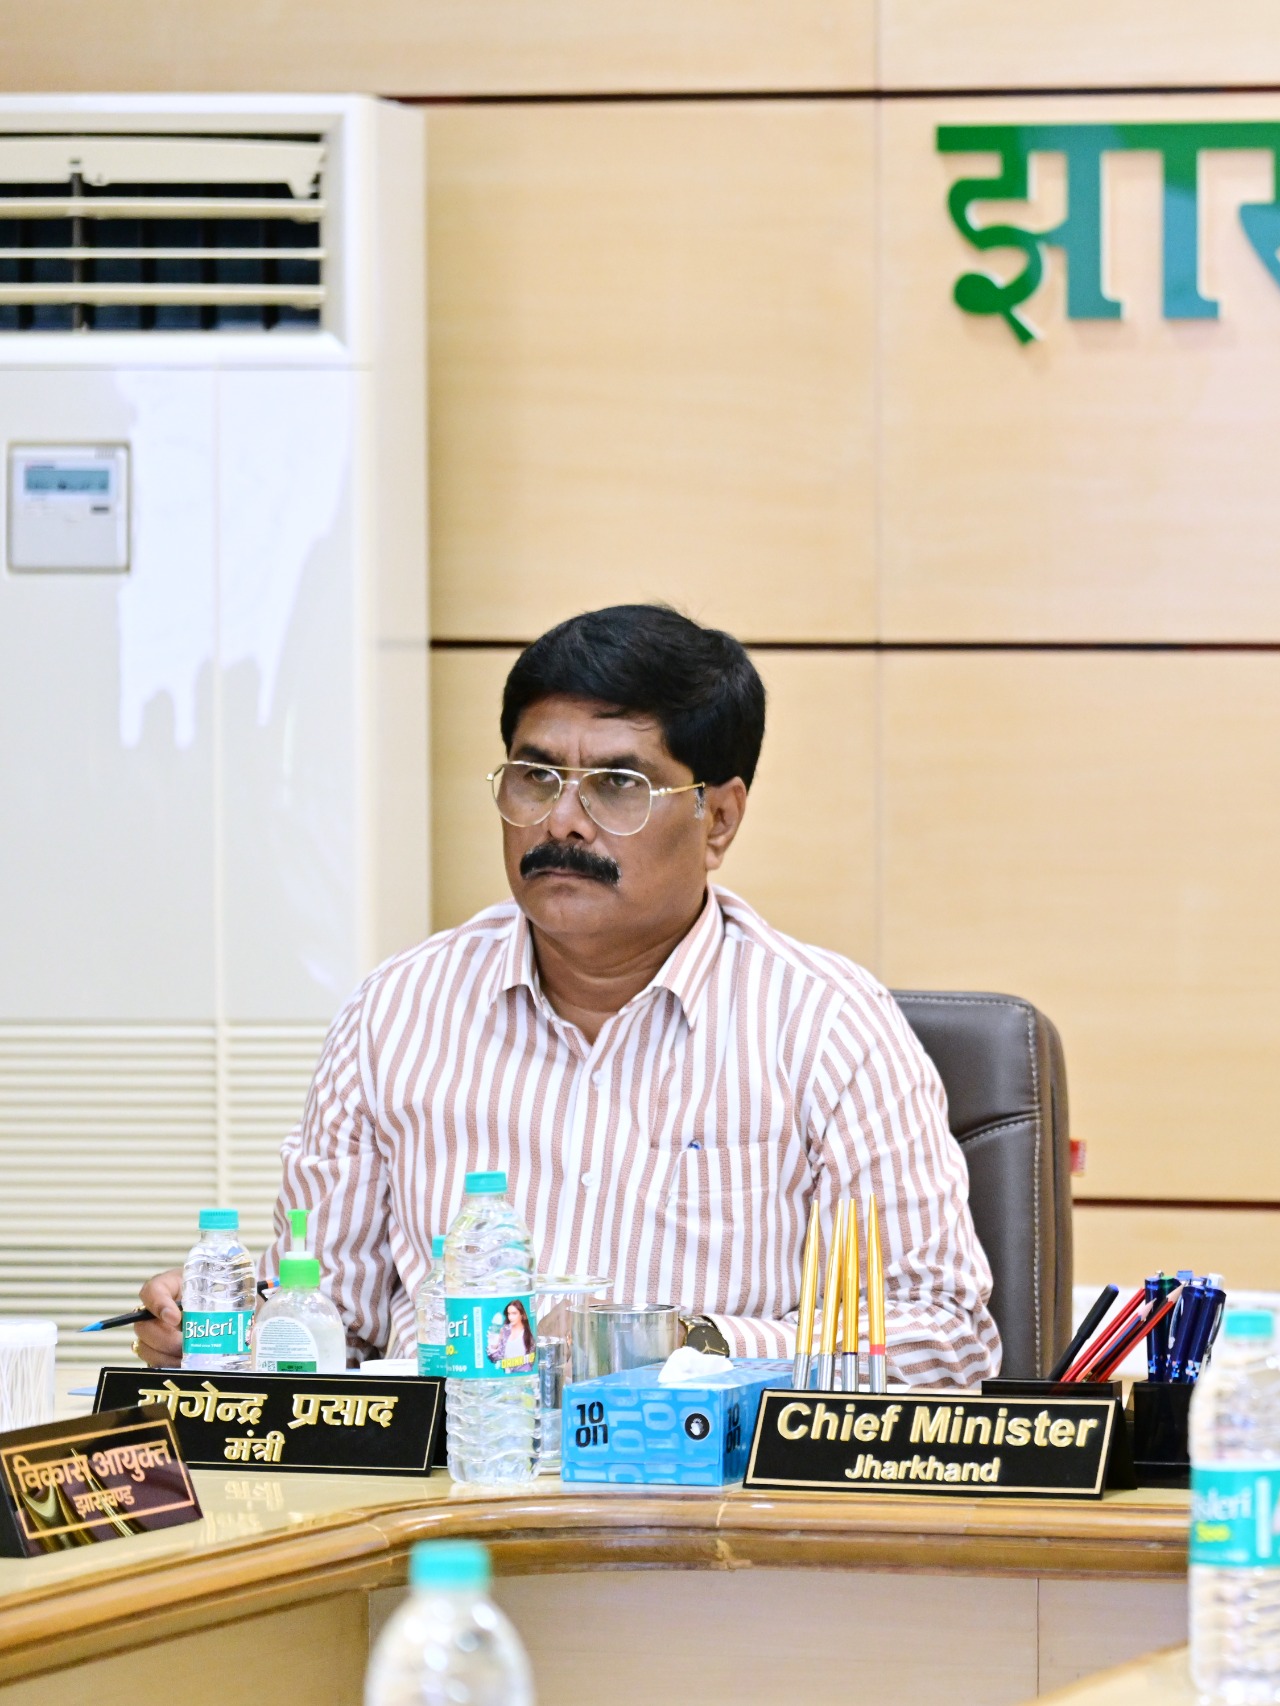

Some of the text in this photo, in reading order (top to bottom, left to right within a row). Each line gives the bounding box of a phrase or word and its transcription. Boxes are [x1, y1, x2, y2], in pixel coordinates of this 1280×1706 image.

[287, 1393, 399, 1430] प्रसाद
[777, 1402, 1098, 1448] Chief Minister
[224, 1429, 286, 1462] मंत्री
[13, 1439, 173, 1493] विकास आयुक्त
[845, 1454, 1001, 1483] Jharkhand
[72, 1485, 136, 1518] झारखण्ड
